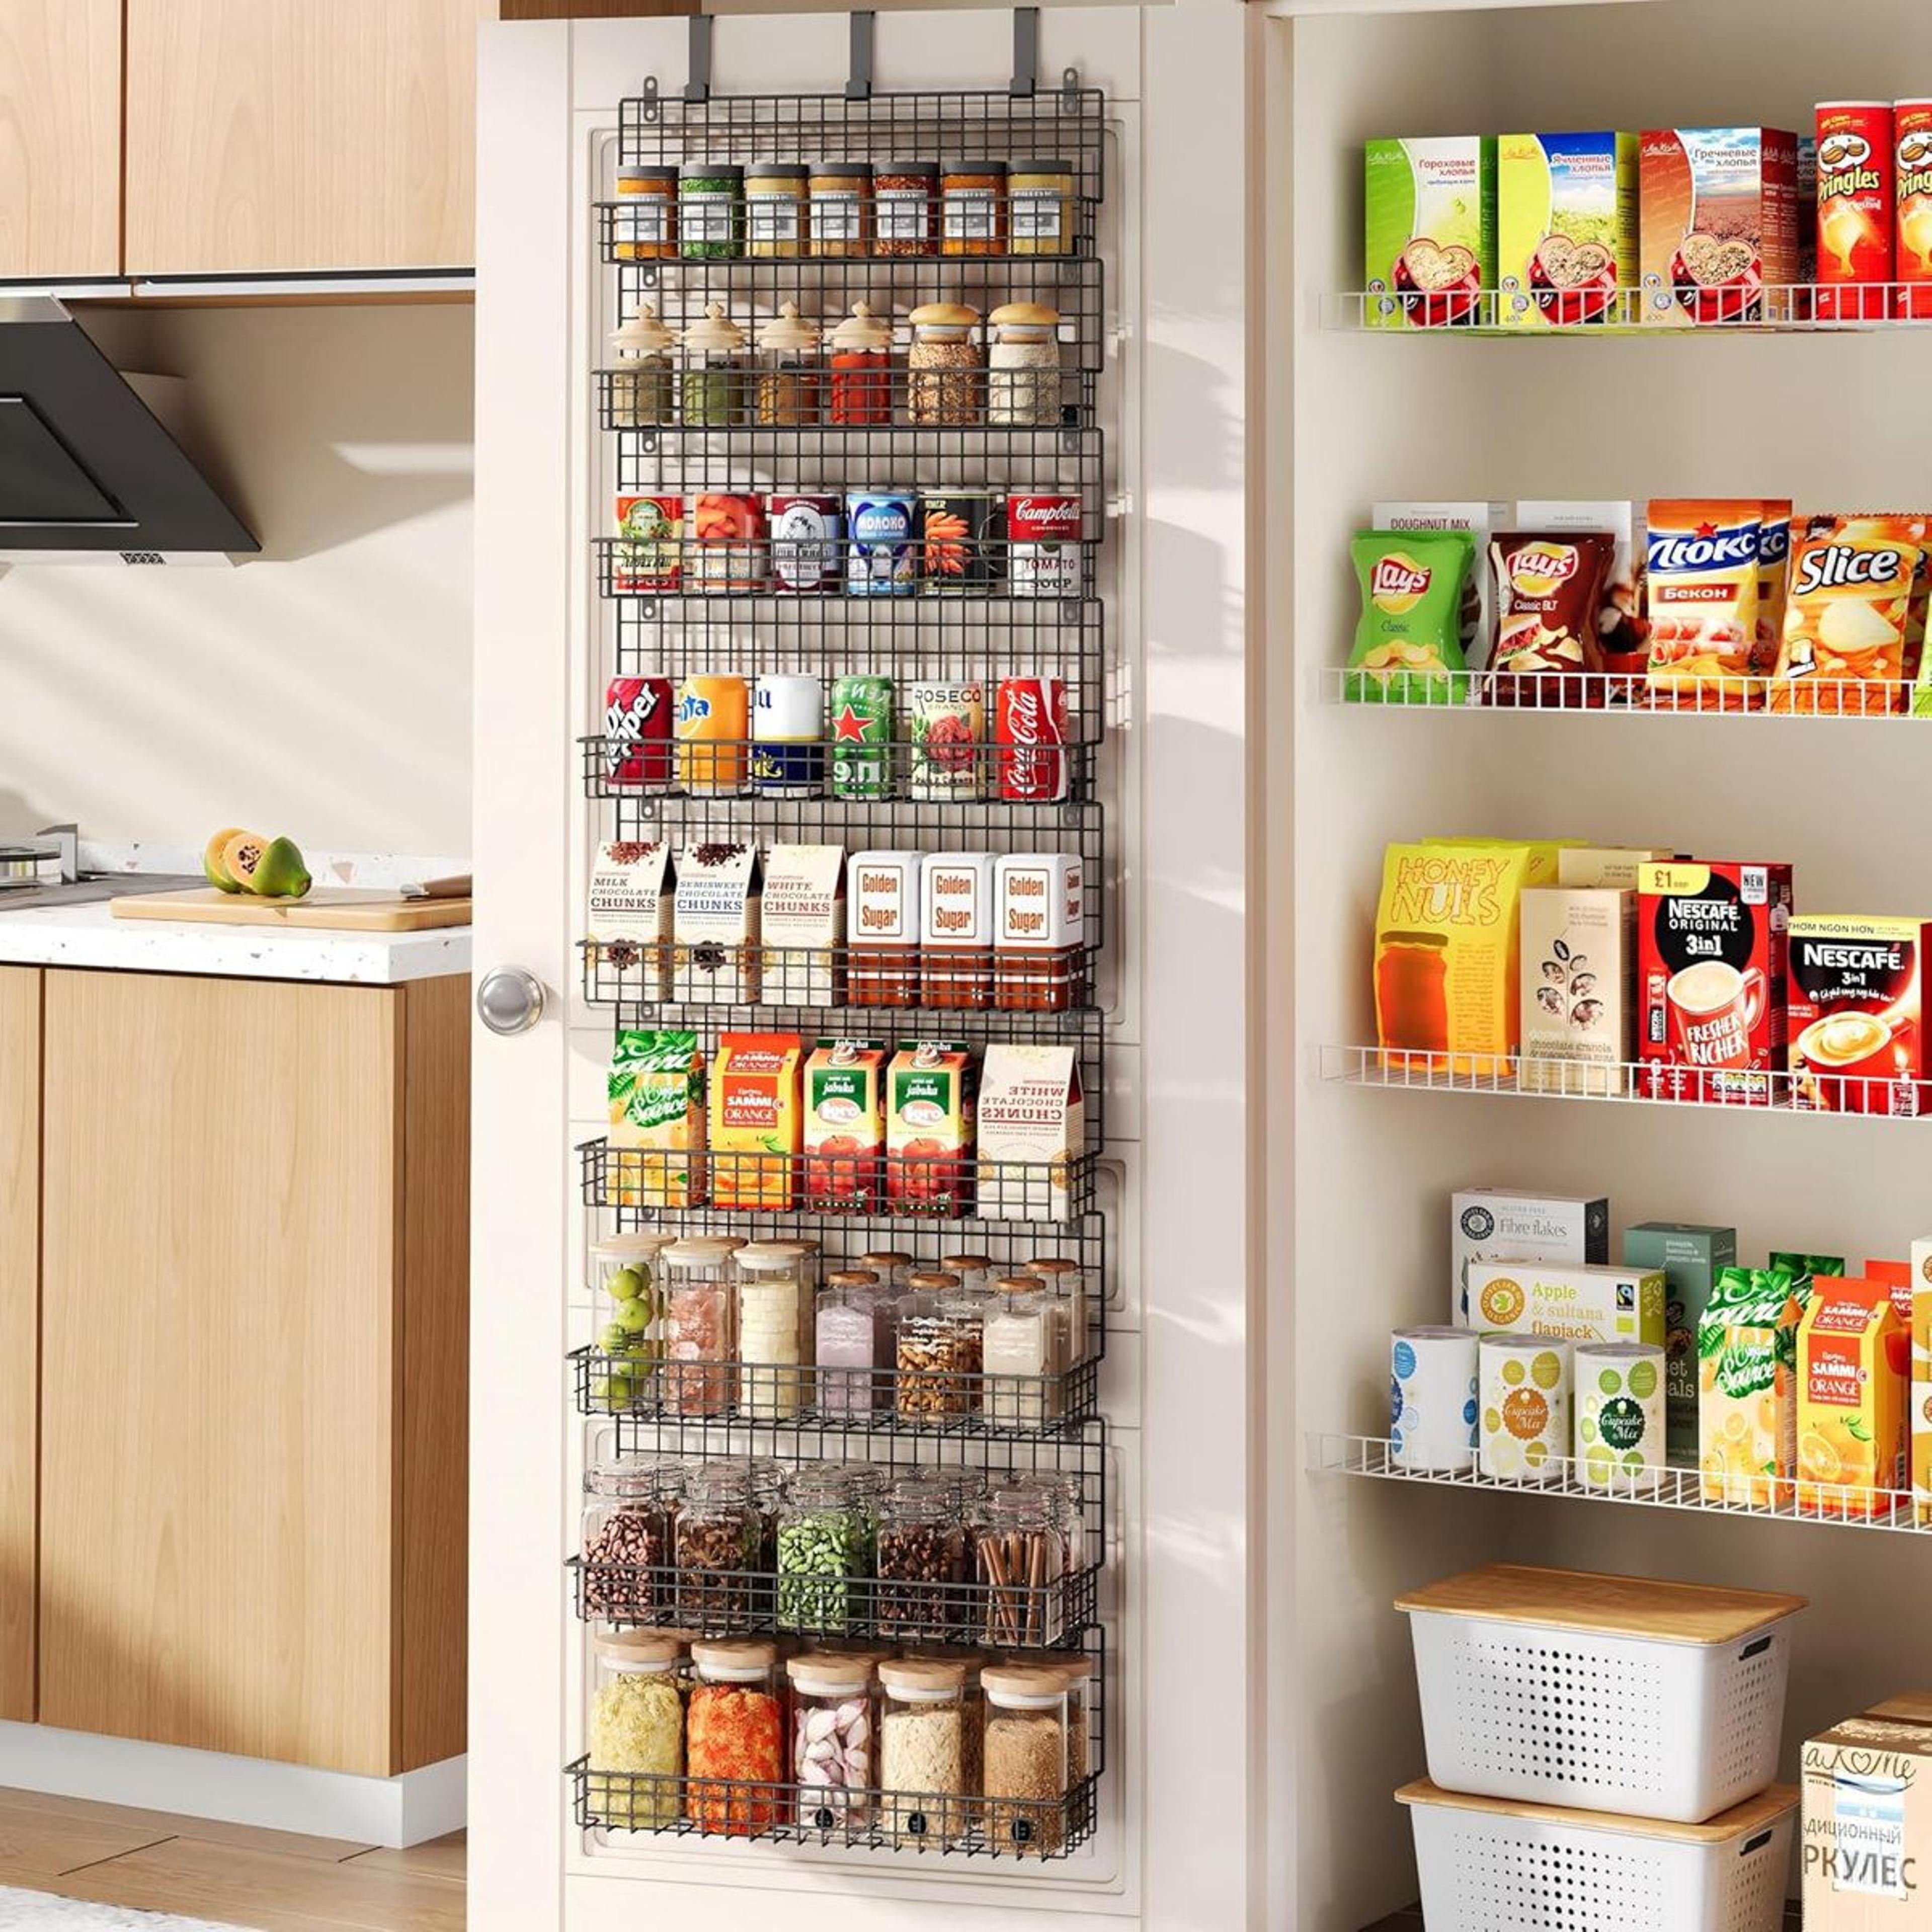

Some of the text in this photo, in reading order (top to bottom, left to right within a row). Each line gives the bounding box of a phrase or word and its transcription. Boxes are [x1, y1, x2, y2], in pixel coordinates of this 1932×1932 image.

[1695, 149, 1757, 159] Гречневые
[1716, 158, 1757, 167] хлопья
[1391, 518, 1471, 530] DOUGHNUT MIX
[1023, 558, 1075, 570] TOMATO
[1794, 546, 1900, 595] Slice
[1030, 579, 1072, 588] SOUP
[1664, 587, 1728, 599] Бекон
[1514, 599, 1542, 611] Classic
[1398, 856, 1511, 887] HONEY
[594, 877, 628, 887] MILK
[679, 880, 745, 890] SEMISWEET
[767, 881, 814, 891] WHITE
[862, 873, 898, 894] Golden
[936, 875, 972, 895] Golden
[1009, 876, 1044, 896] Golden
[1743, 873, 1765, 887] NEW
[592, 889, 657, 897] CHOCOLATE
[678, 890, 744, 898] CHOCOLATE
[765, 892, 832, 900] CHOCOLATE
[591, 898, 656, 909] CHUNKS
[677, 899, 743, 910] CHUNKS
[764, 901, 832, 913] CHUNKS
[862, 906, 898, 930] Sugar
[936, 907, 972, 931] Sugar
[1009, 908, 1044, 932] Sugar
[1669, 919, 1738, 932] ORIGINAL
[724, 1107, 775, 1120] ORANGE
[1499, 1218, 1568, 1237] Fibre flakes
[1532, 1281, 1577, 1302] Apple
[1546, 1304, 1603, 1321] sultana
[1816, 1315, 1867, 1328] ORANGE
[1532, 1320, 1592, 1339] flapjack
[1668, 1361, 1688, 1378] et
[1812, 1362, 1856, 1378] SAMMI
[1667, 1380, 1696, 1398] als
[1809, 1378, 1859, 1396] ORANGE
[1600, 1413, 1643, 1428] Cupcake
[1804, 1817, 1901, 1844] ДИЦИОННЫЙ
